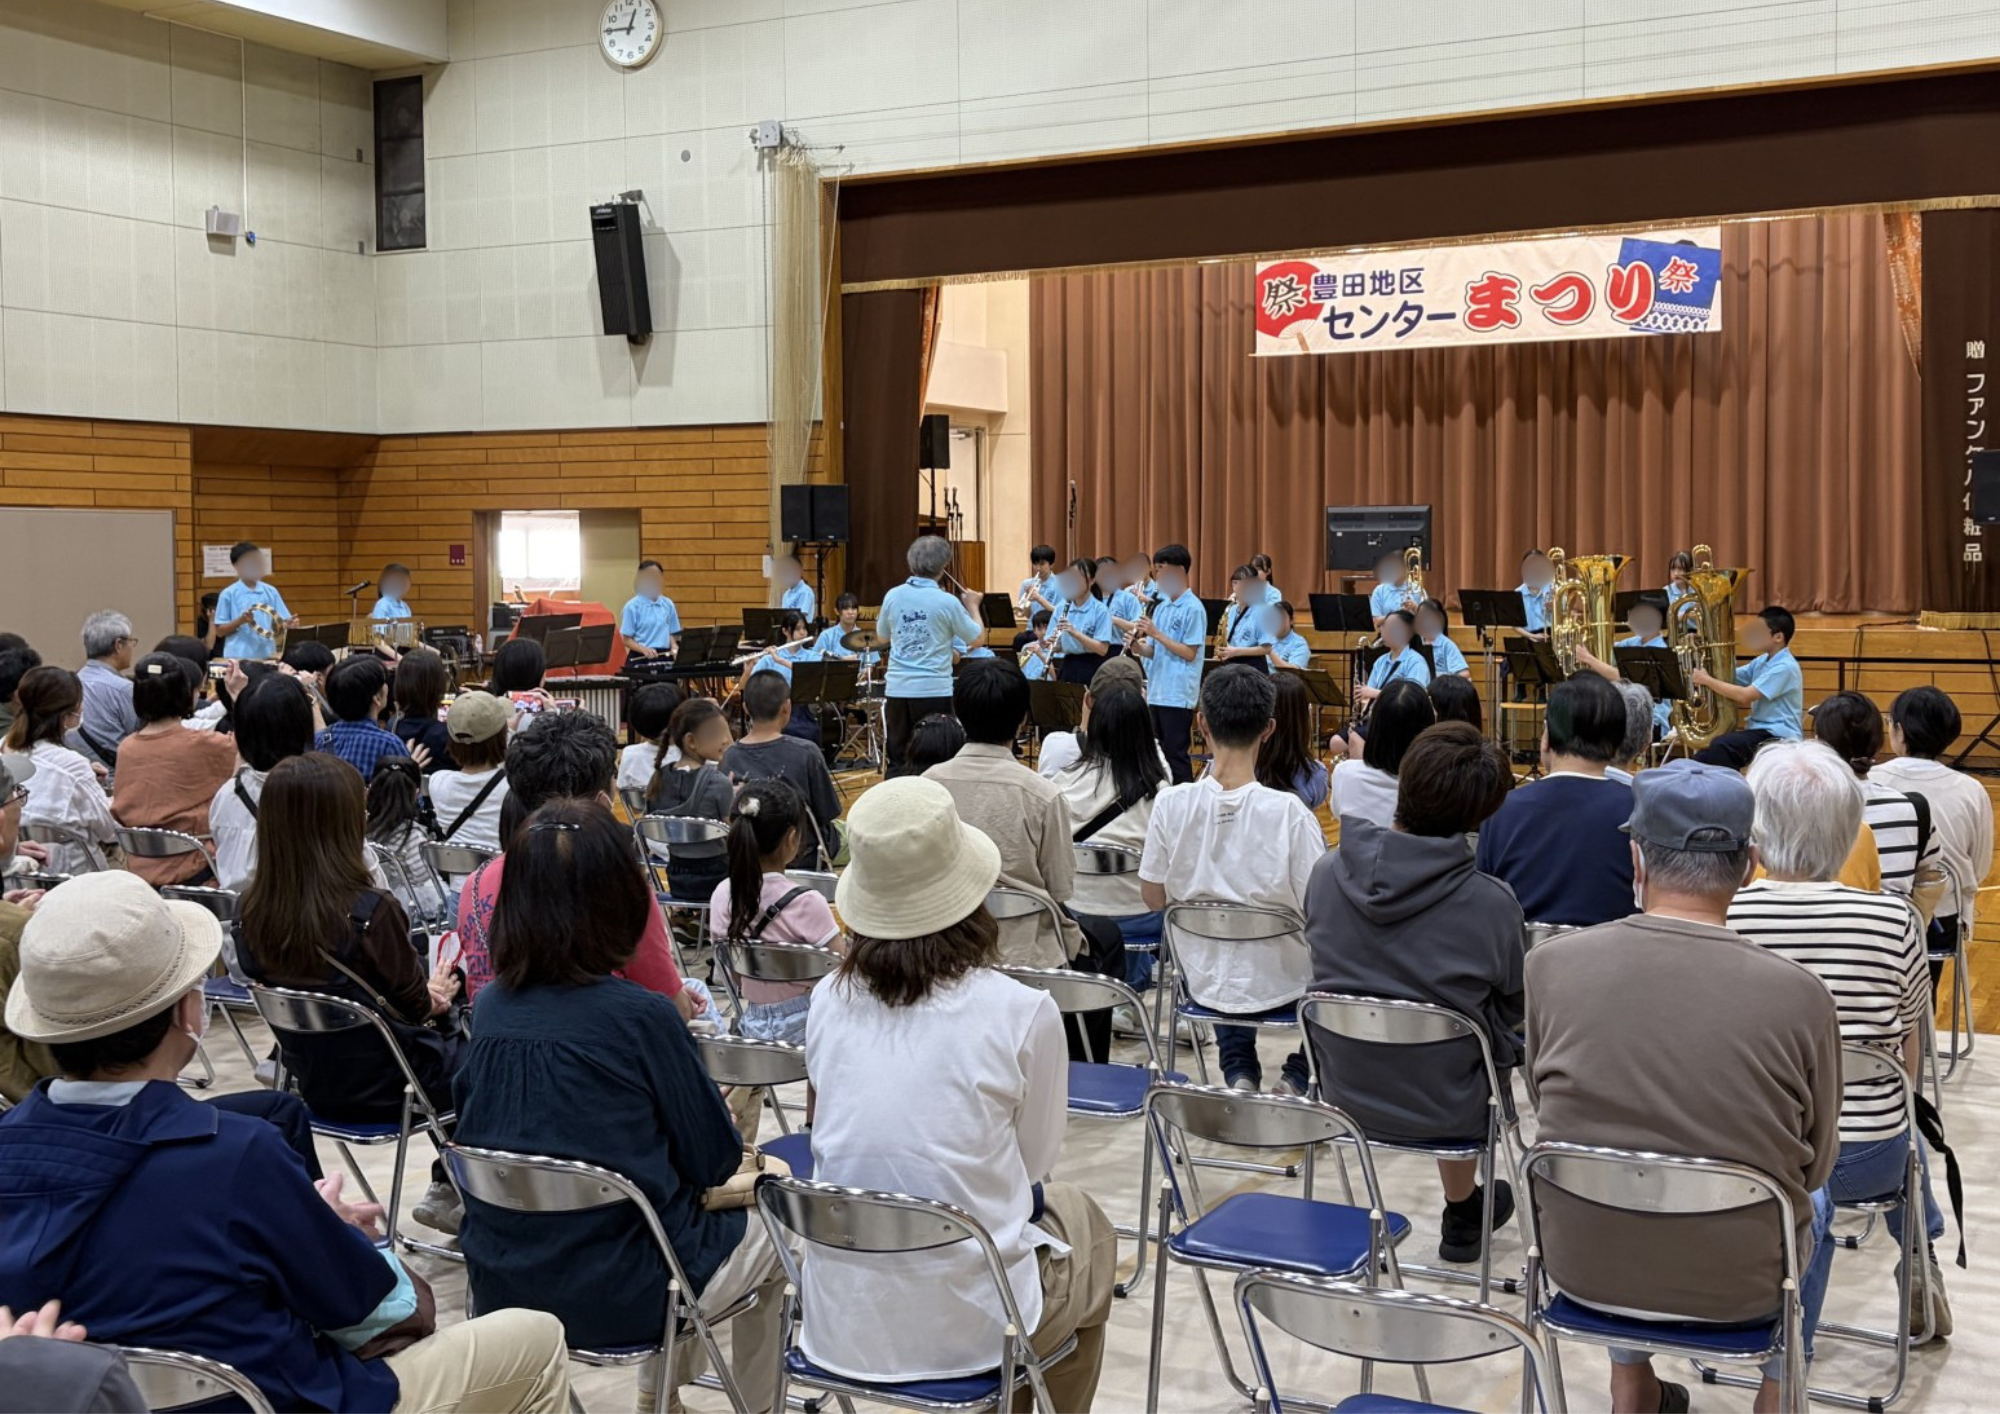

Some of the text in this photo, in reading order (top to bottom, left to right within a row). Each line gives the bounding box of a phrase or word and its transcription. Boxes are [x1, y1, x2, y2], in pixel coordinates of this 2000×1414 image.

[615, 4, 623, 12] 11
[645, 8, 651, 17] 2
[608, 15, 617, 24] 10
[648, 21, 654, 30] 3
[645, 34, 652, 42] 4
[609, 39, 615, 47] 8
[618, 49, 623, 57] 7
[638, 46, 645, 54] 5
[627, 51, 634, 59] 6
[1657, 256, 1700, 294] 祭
[1312, 267, 1426, 301] 豊田地区
[1263, 275, 1307, 319] 祭
[1465, 262, 1655, 331] まつり
[1322, 299, 1457, 340] センター
[1965, 340, 1985, 359] 贈
